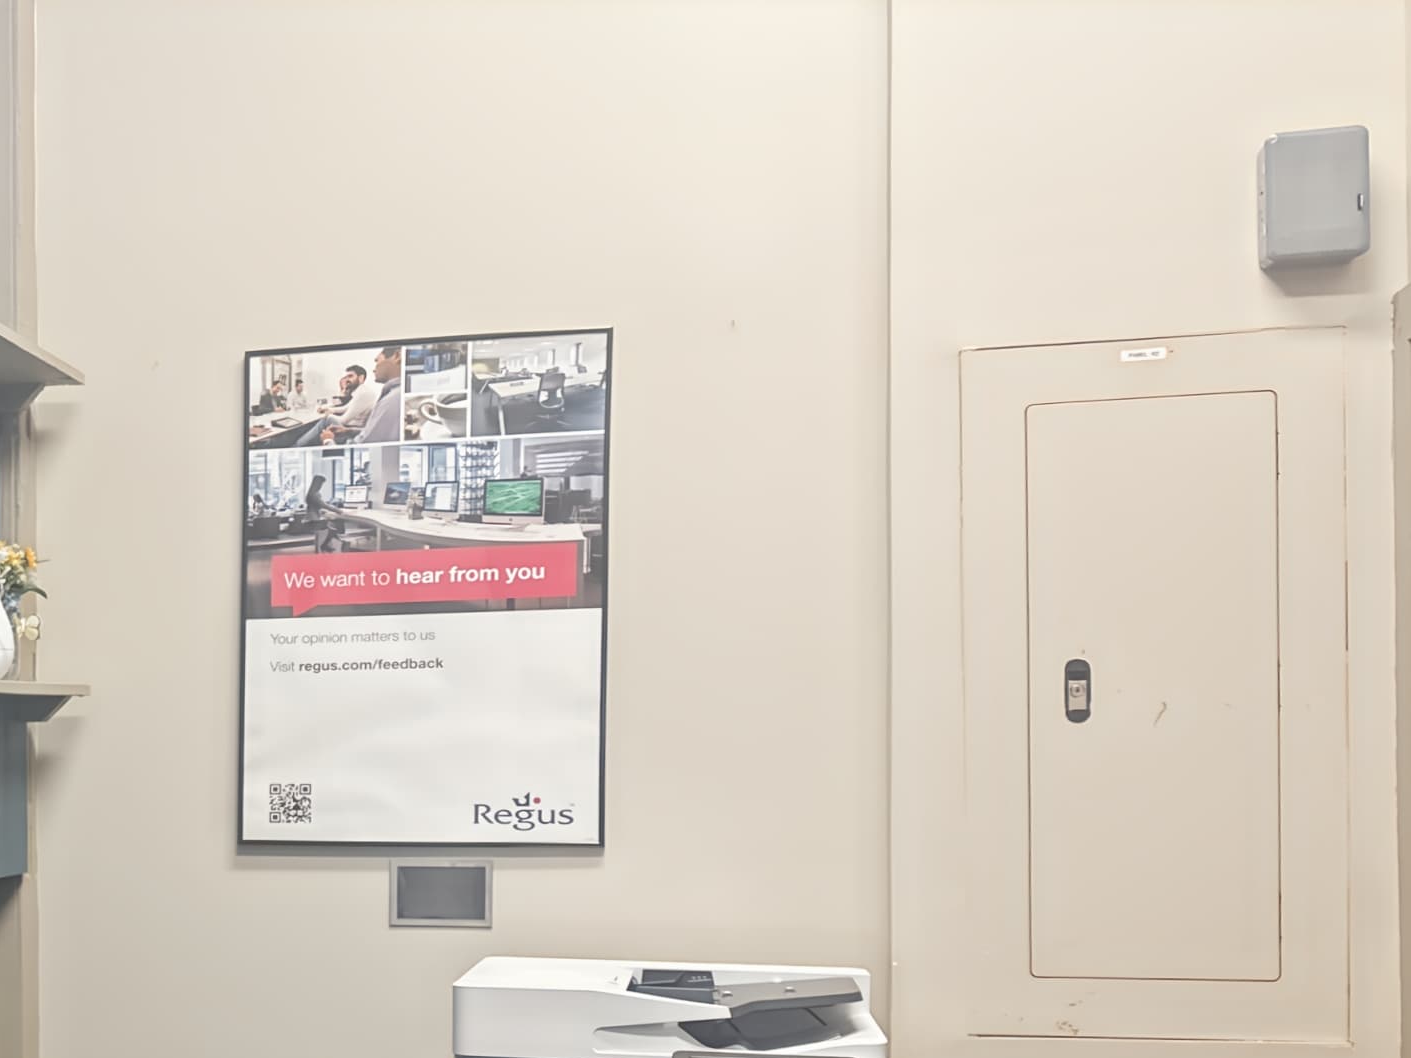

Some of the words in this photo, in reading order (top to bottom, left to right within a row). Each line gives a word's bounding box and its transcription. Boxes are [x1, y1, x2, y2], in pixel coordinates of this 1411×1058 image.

[284, 572, 315, 588] We
[320, 571, 365, 588] want
[372, 570, 390, 586] to
[396, 568, 444, 585] hear
[449, 566, 499, 583] from
[506, 566, 546, 584] you
[270, 632, 298, 645] Your
[302, 632, 347, 647] opinion
[351, 630, 399, 643] matters
[403, 630, 416, 642] to
[420, 631, 436, 641] us
[269, 660, 295, 673] Visit
[299, 658, 444, 674] regus.com/feedback
[473, 800, 575, 831] Regus
